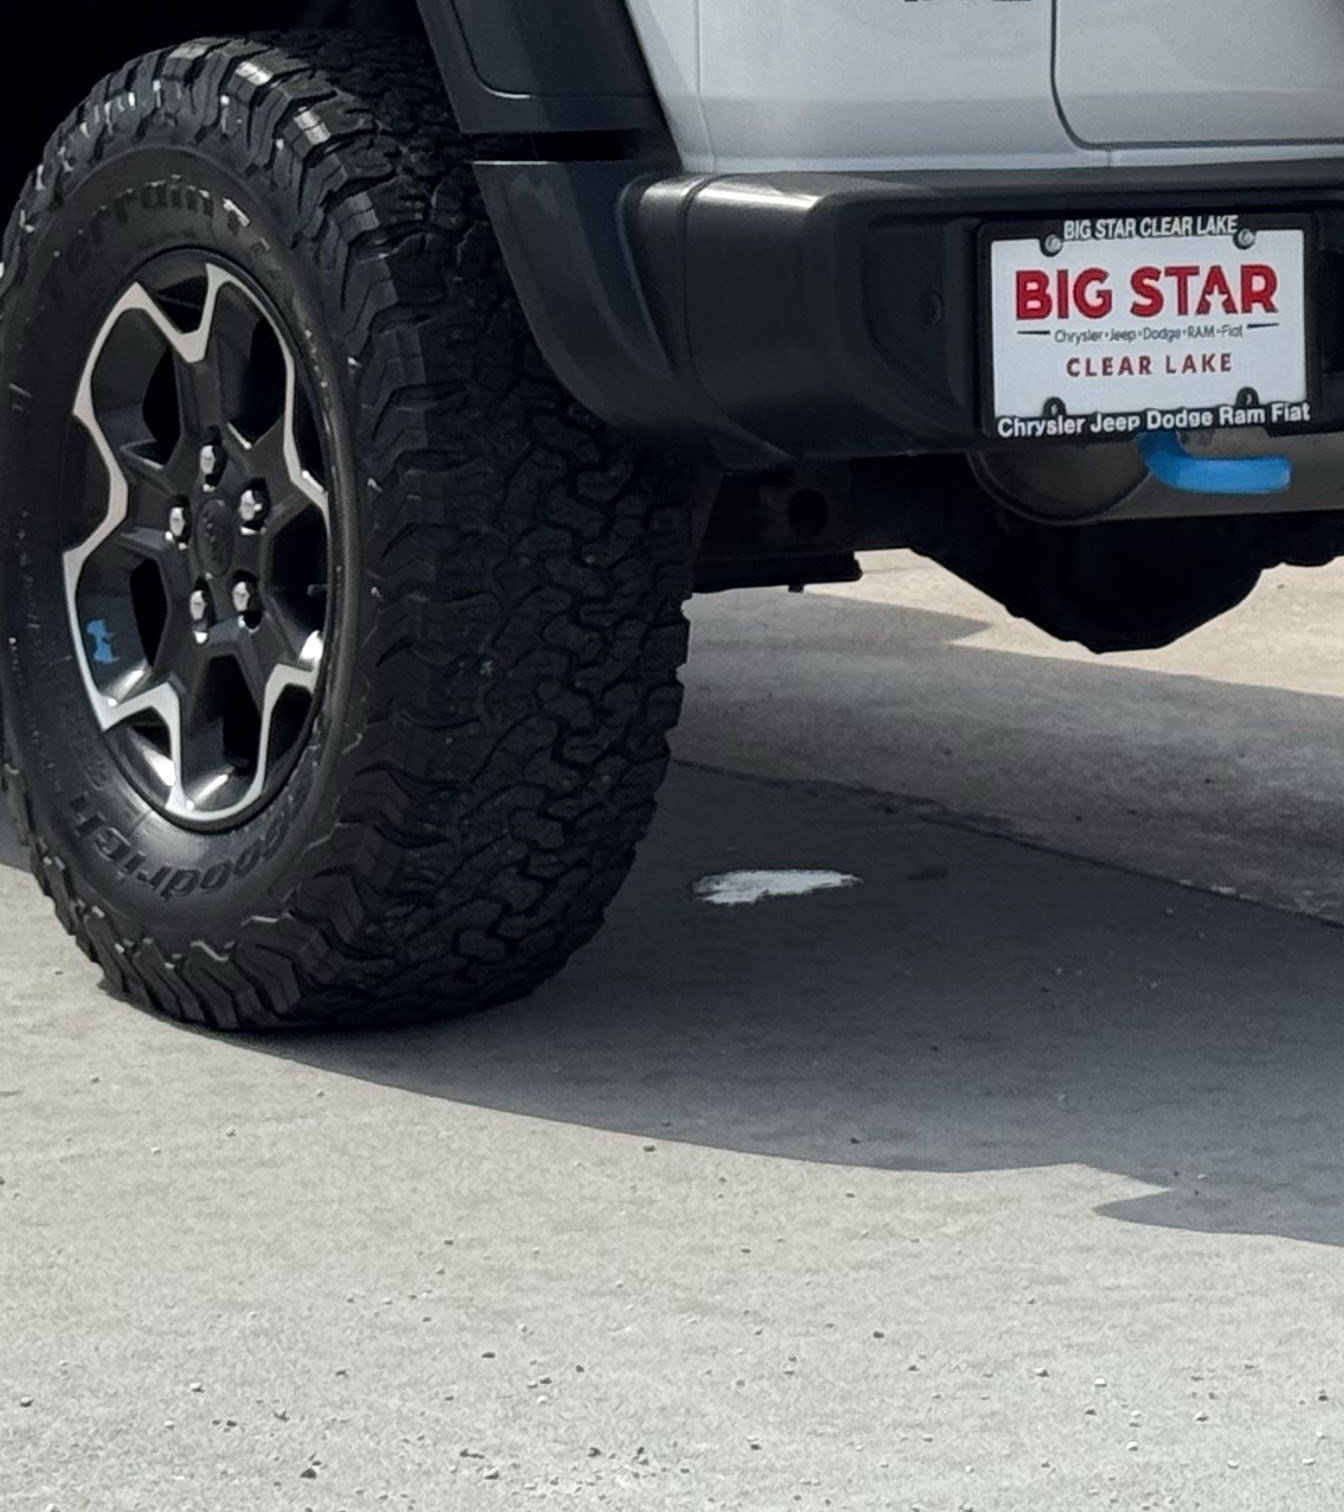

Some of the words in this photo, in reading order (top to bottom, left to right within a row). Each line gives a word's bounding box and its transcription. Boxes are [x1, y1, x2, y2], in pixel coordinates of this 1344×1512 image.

[1063, 219, 1093, 239] BIG
[1094, 218, 1137, 238] STAR
[1139, 216, 1193, 237] CLEAR
[1195, 214, 1239, 236] LAKE
[1015, 267, 1113, 320] BIG
[1129, 264, 1279, 317] STAR
[1066, 355, 1152, 377] CLEAR
[1165, 352, 1232, 375] LAKE
[997, 414, 1085, 438] Chrysler
[1090, 411, 1140, 433] Jeep
[1146, 408, 1213, 430] Dodge
[1219, 405, 1266, 425] Ram
[1271, 401, 1311, 423] Fiat
